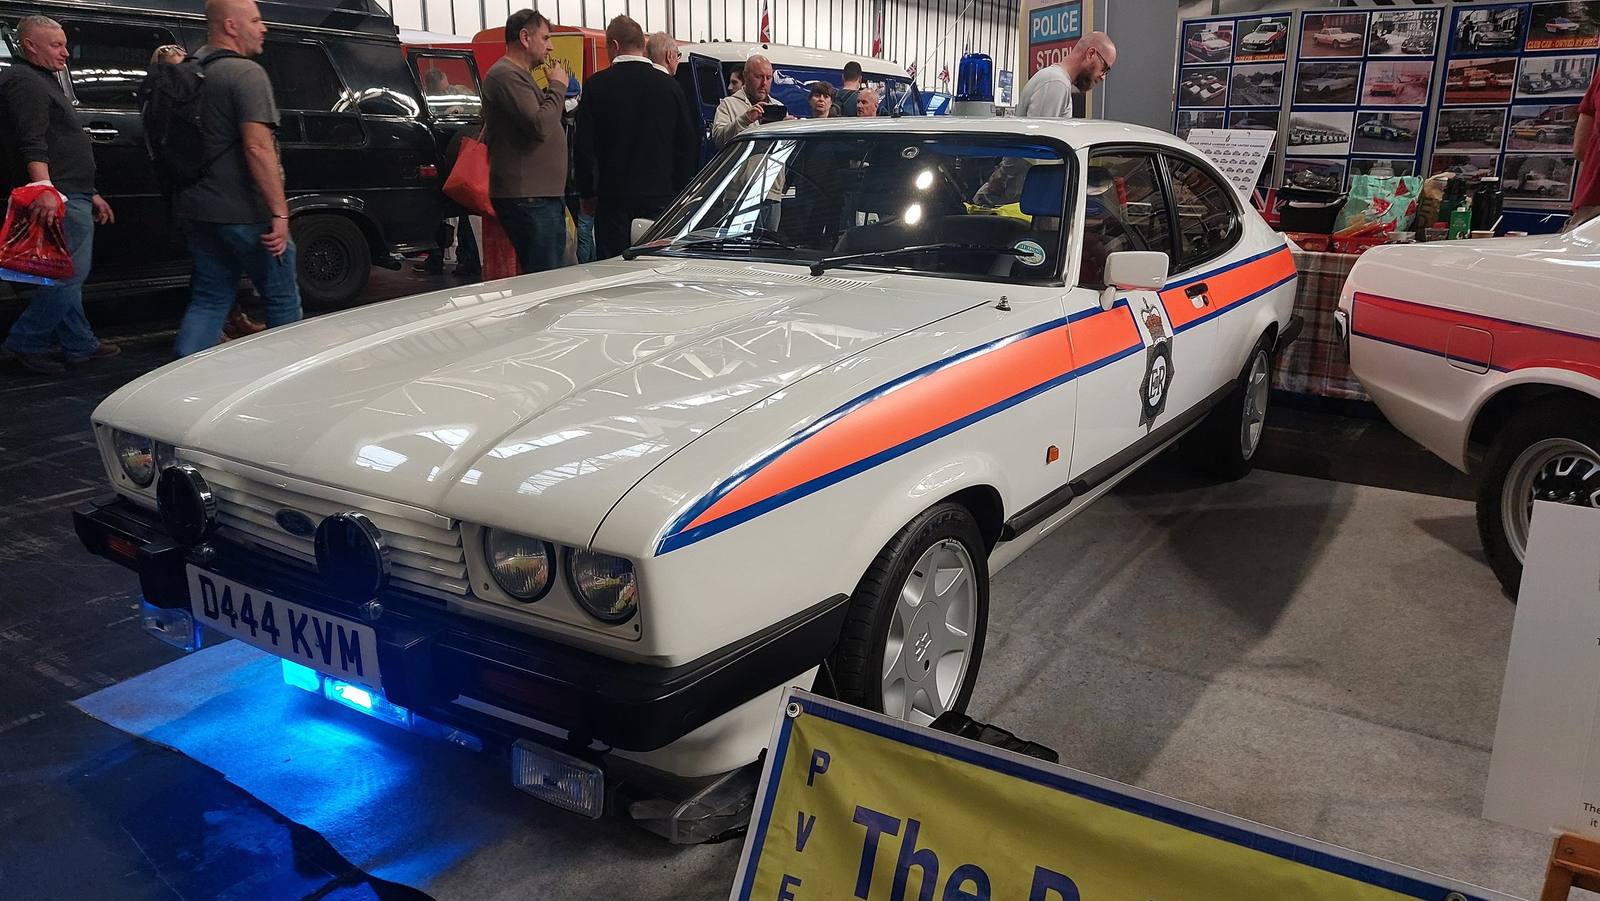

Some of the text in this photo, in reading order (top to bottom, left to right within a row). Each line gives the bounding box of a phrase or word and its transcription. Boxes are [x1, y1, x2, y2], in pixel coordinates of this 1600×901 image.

[1033, 10, 1078, 38] POLICE
[198, 574, 364, 677] D444 KVM
